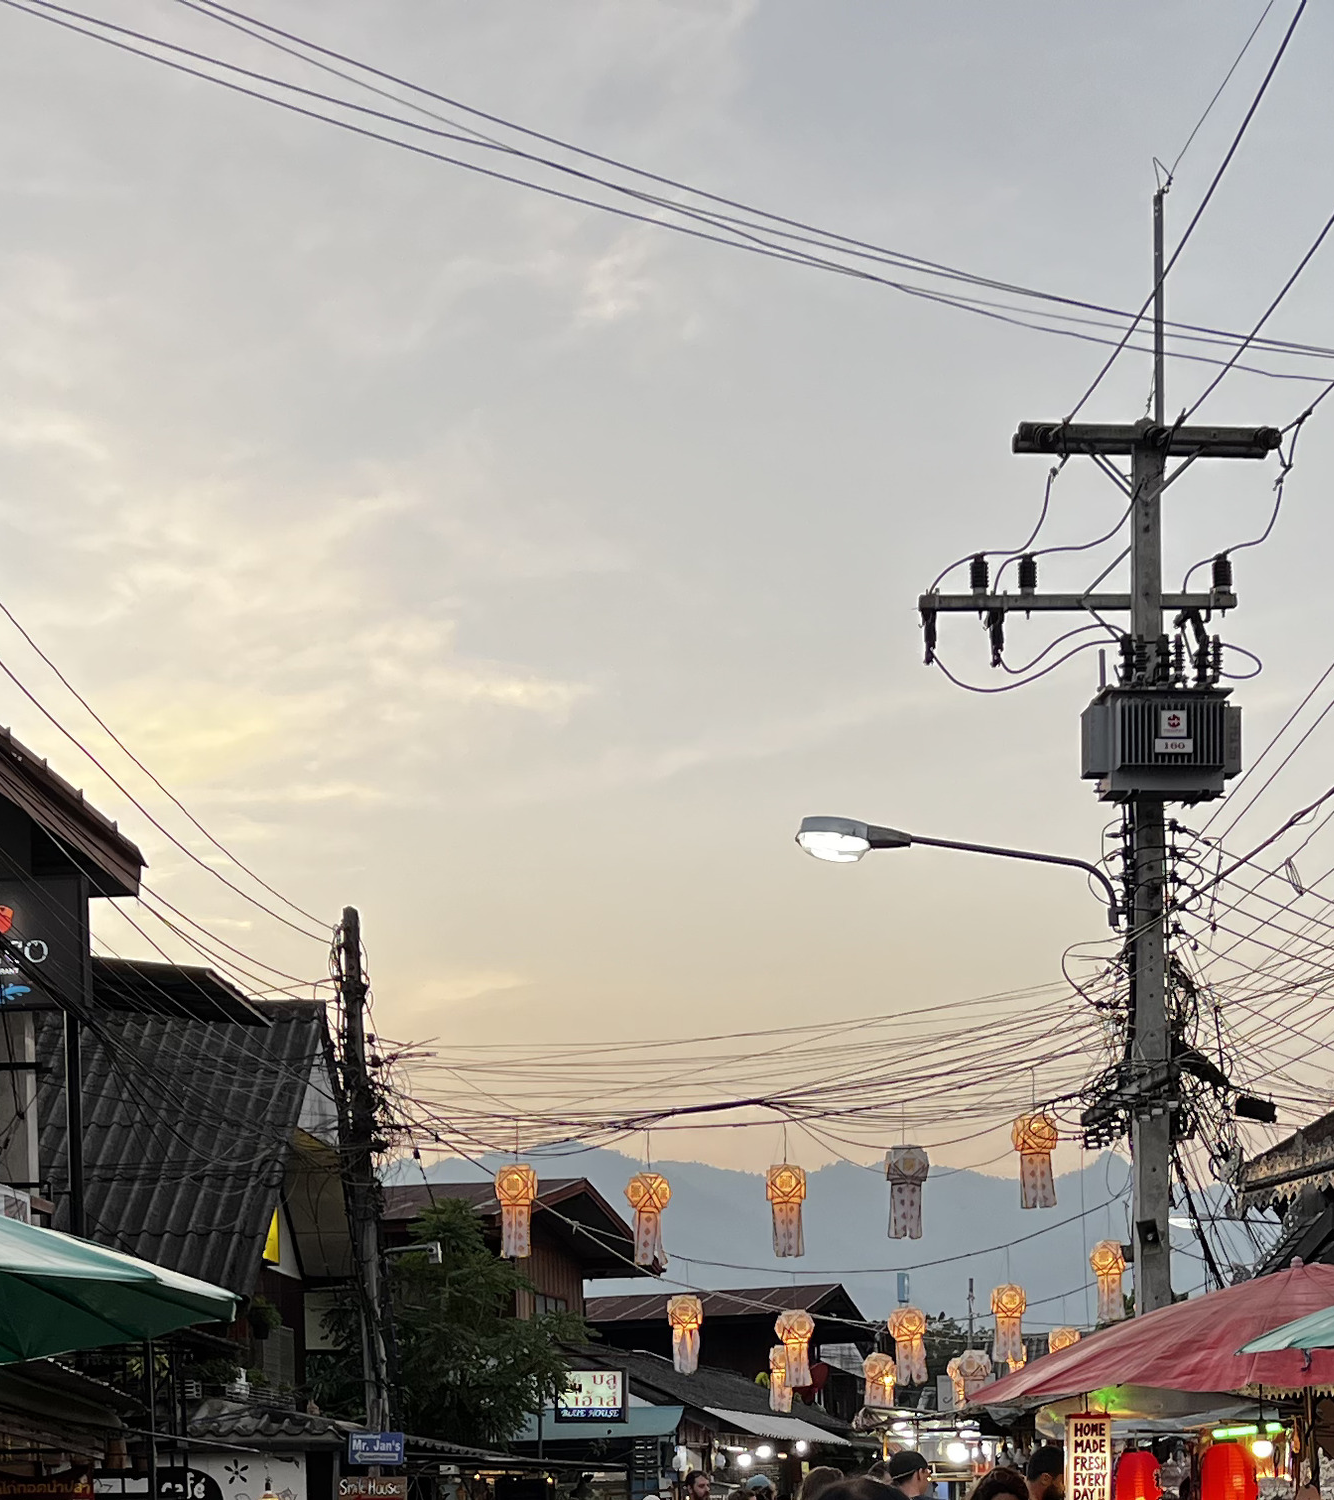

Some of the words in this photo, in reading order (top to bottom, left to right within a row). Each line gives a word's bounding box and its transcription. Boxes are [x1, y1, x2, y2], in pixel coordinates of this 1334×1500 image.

[587, 1409, 620, 1418] HOUSE
[1074, 1422, 1106, 1437] HOME
[352, 1439, 369, 1452] Mr.
[373, 1439, 401, 1452] Jan's
[1074, 1439, 1106, 1454] MADE
[1073, 1455, 1107, 1471] FRESH
[368, 1477, 401, 1495] House
[1073, 1472, 1108, 1487] EVERY
